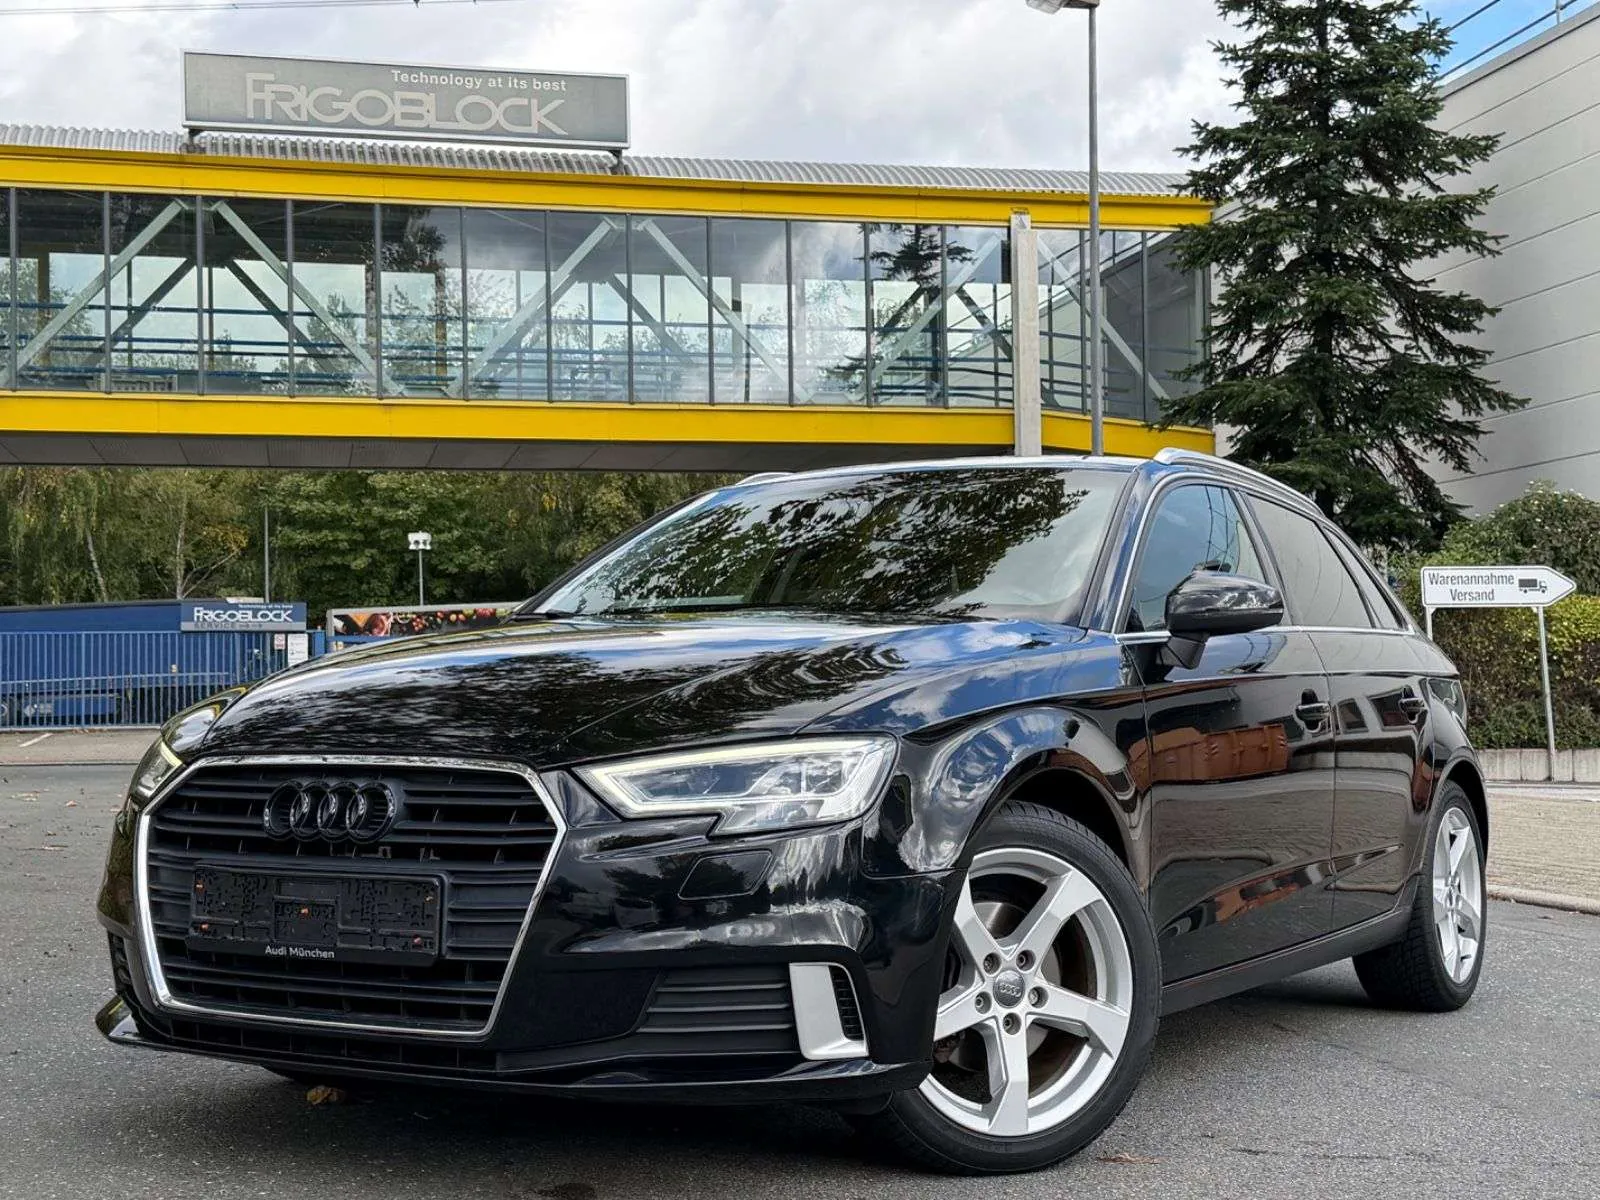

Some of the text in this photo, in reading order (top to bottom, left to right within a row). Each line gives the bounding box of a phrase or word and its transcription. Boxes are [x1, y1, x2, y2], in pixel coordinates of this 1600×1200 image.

[391, 69, 567, 92] Technology at its best
[245, 72, 568, 136] FRIGOBLOCK
[1428, 572, 1515, 586] Warenannahme
[1450, 588, 1495, 602] Versand
[194, 607, 293, 622] FRIGOBLOCK
[265, 945, 334, 958] Audi München
